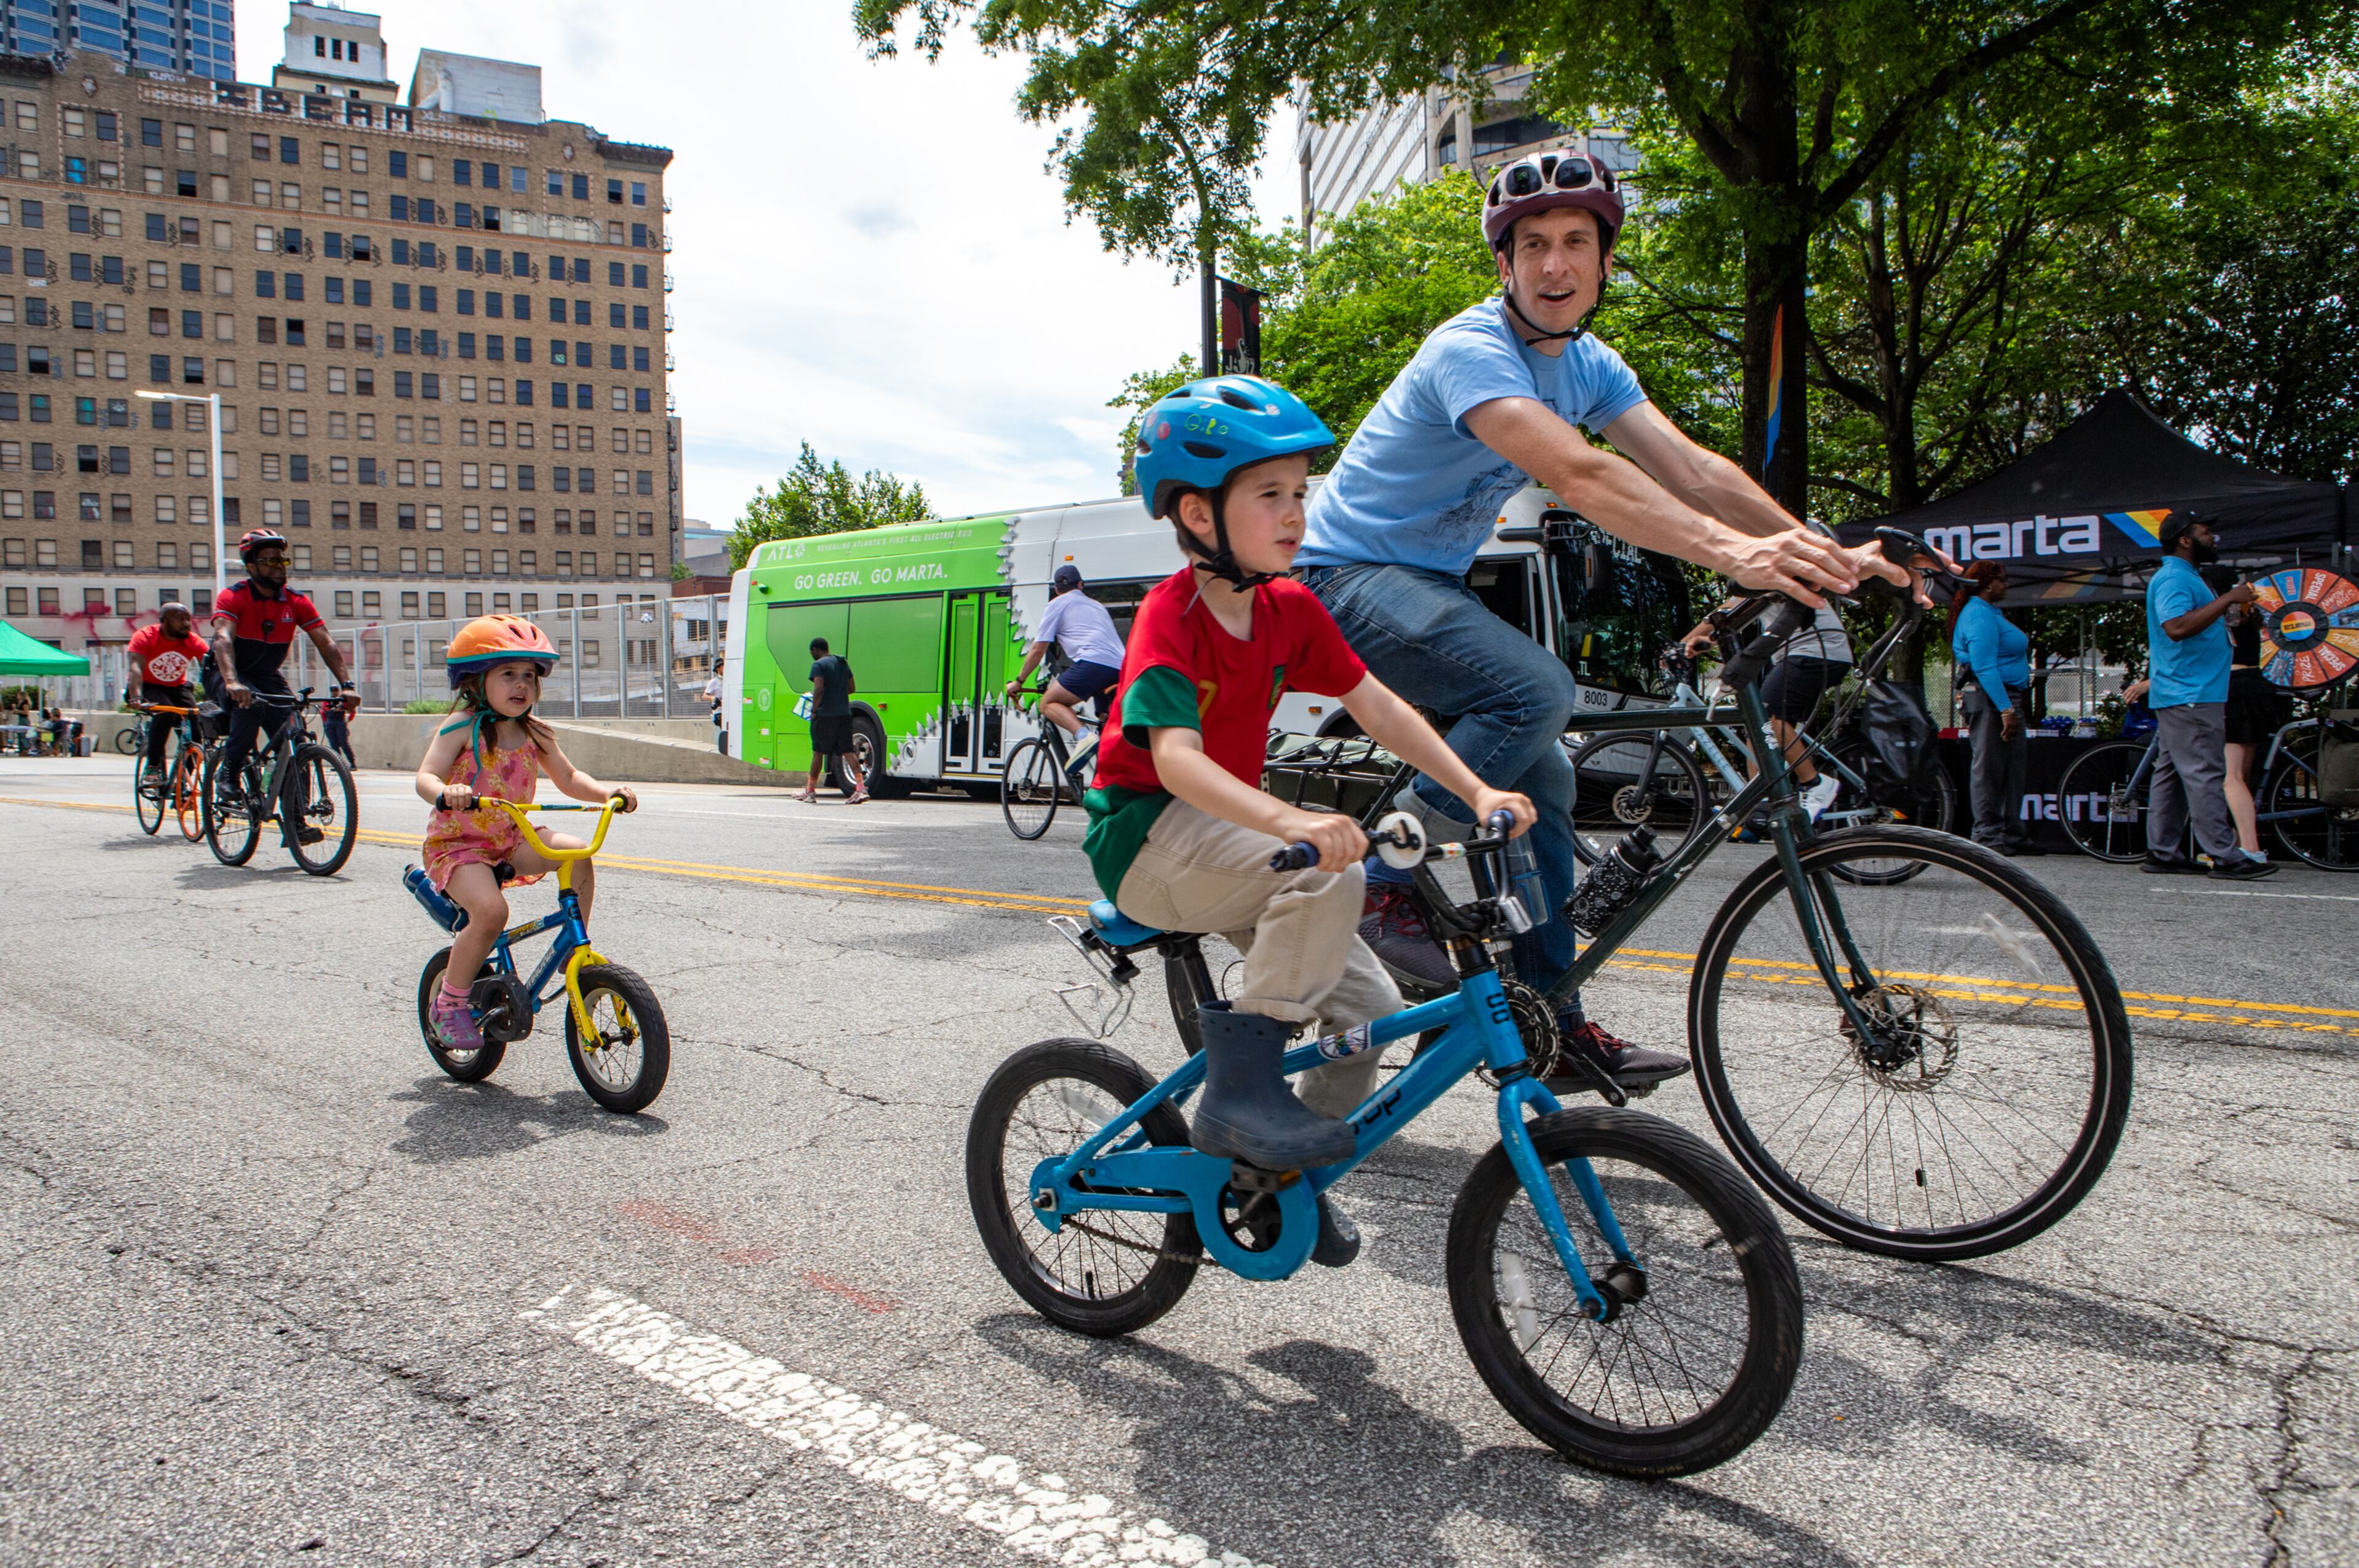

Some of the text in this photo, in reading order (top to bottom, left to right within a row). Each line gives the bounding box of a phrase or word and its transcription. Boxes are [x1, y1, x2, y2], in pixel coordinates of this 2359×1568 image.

[817, 542, 851, 552] REVEALING
[853, 538, 886, 548] ATLANTA'S
[890, 536, 908, 544] FIRST
[924, 531, 955, 540] ELECTRIC
[1923, 515, 2100, 561] marta
[767, 545, 793, 561] ATL
[795, 563, 948, 590] GO GREEN. GO MARTA.
[2305, 572, 2326, 600] SPECIAL
[1577, 660, 1591, 676] TL
[2318, 646, 2346, 671] SPECIAL
[1584, 690, 1608, 706] 8003
[1694, 729, 1731, 771] AZELLE
